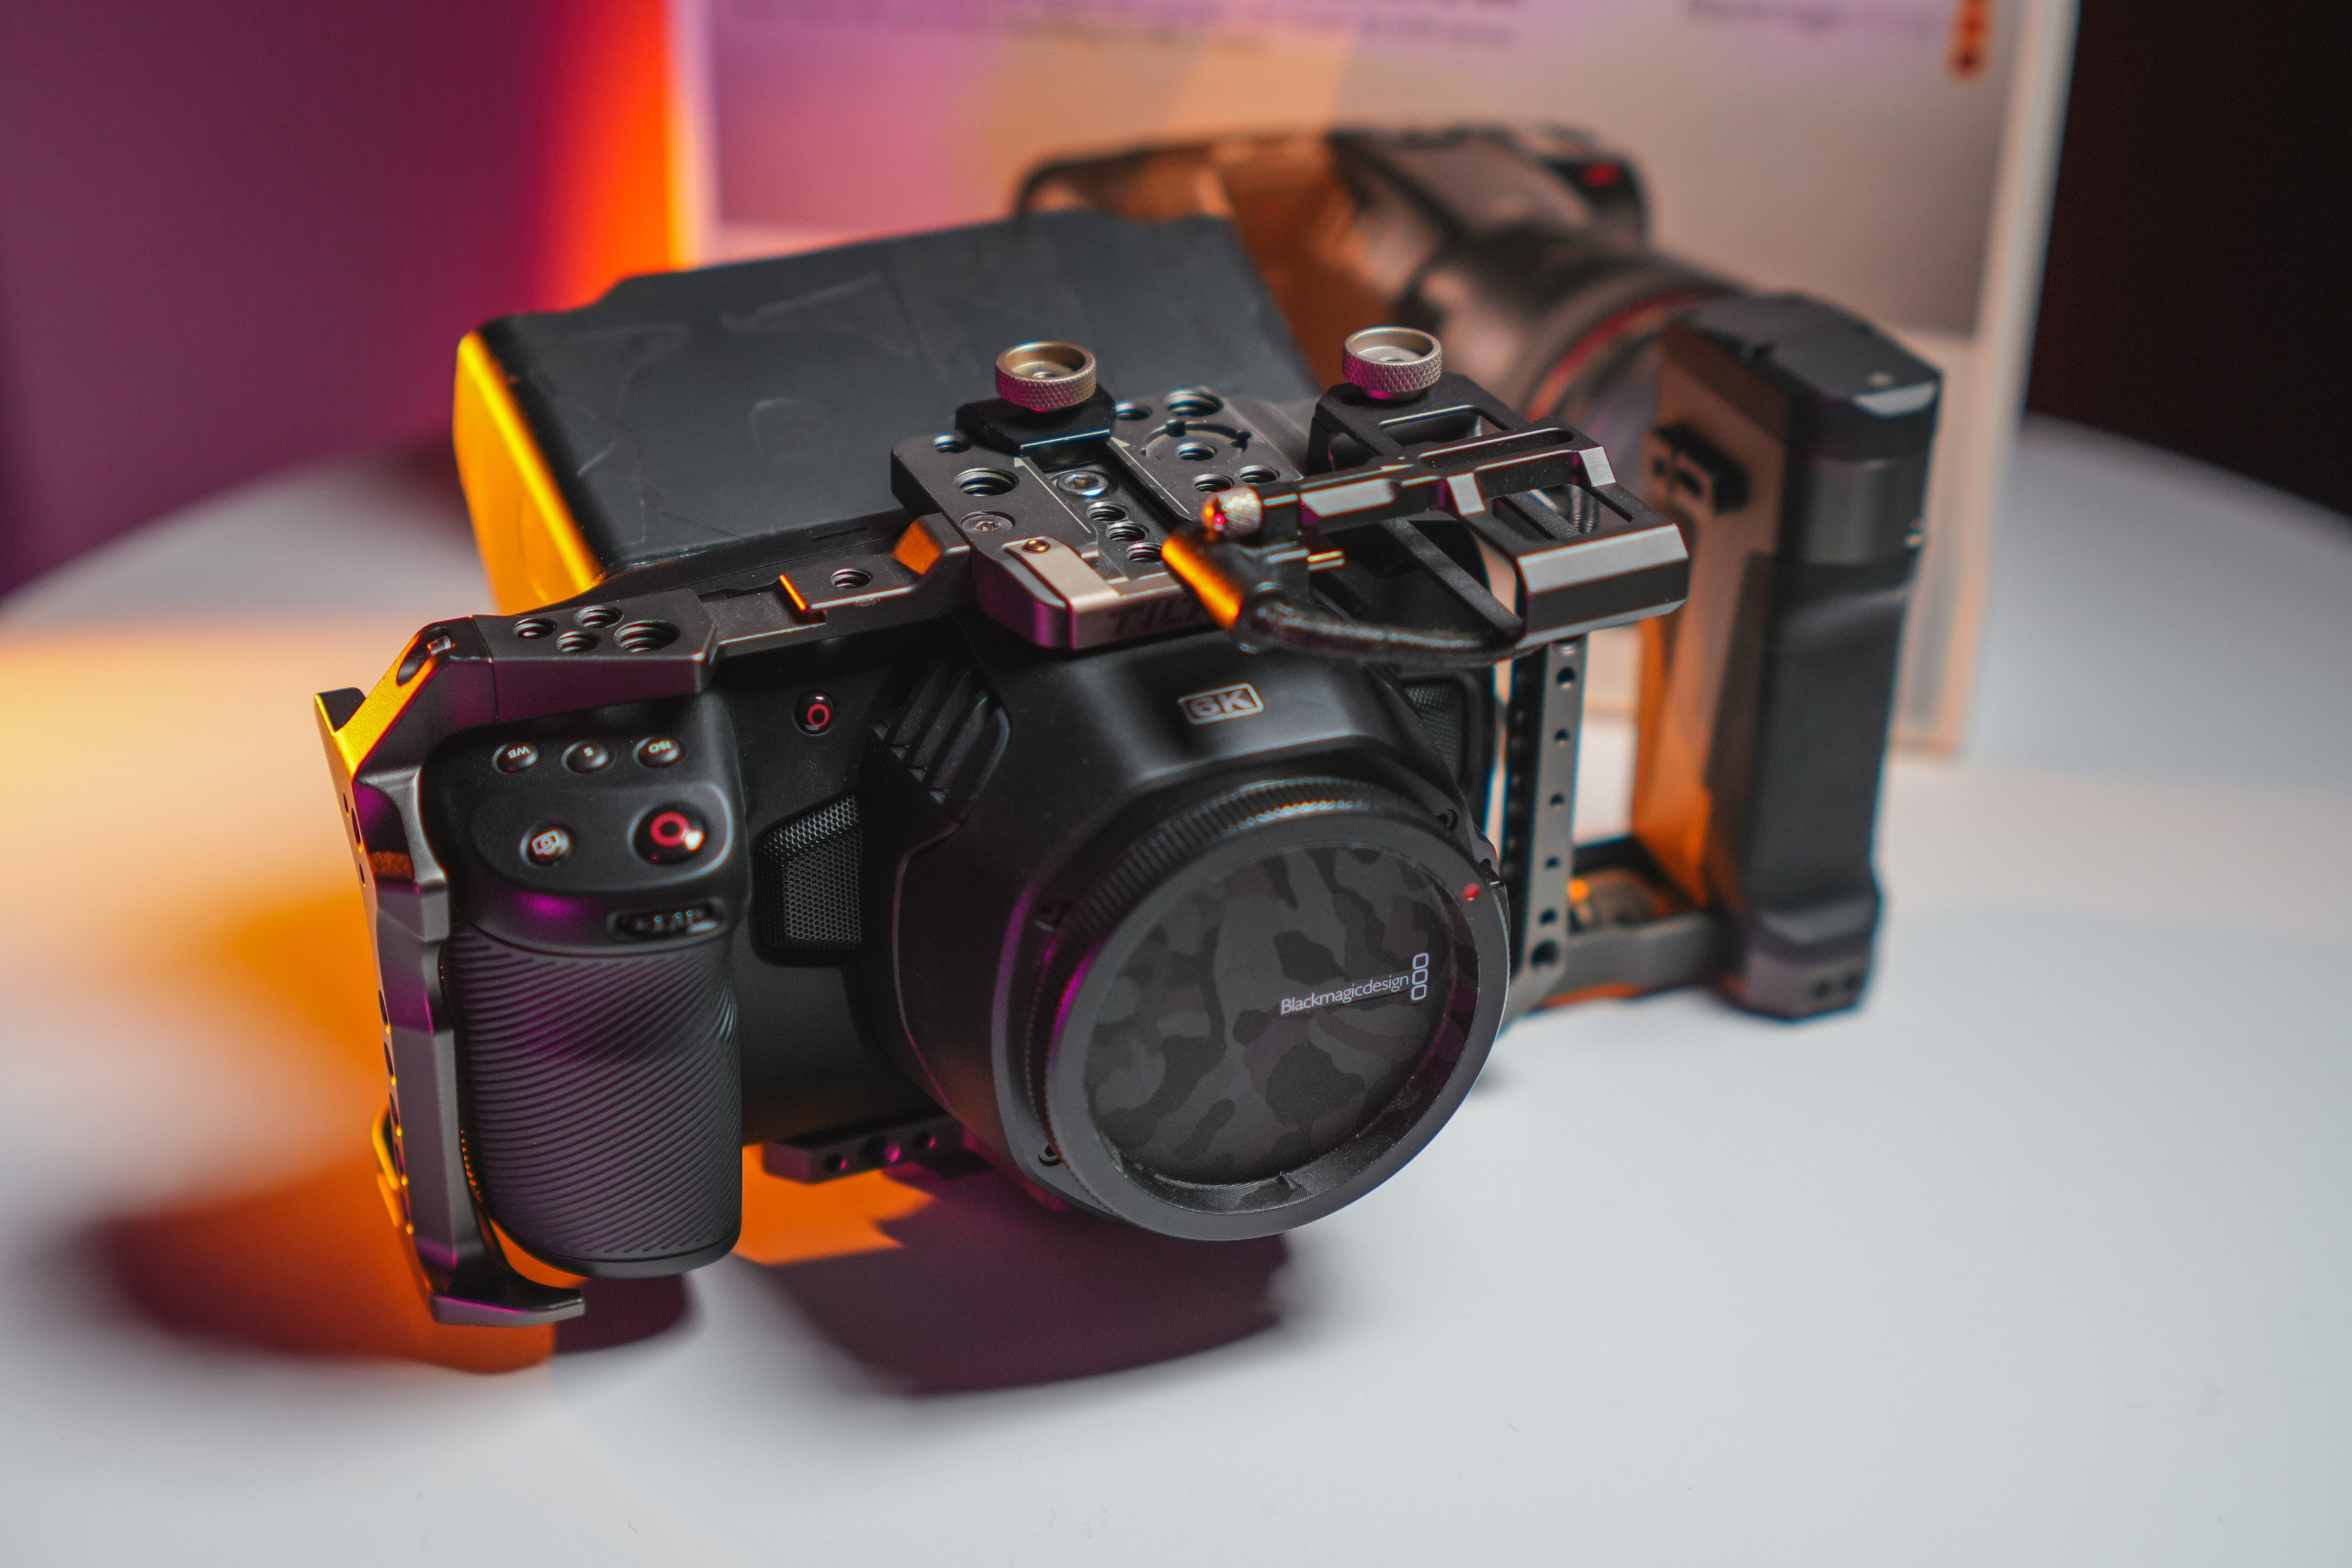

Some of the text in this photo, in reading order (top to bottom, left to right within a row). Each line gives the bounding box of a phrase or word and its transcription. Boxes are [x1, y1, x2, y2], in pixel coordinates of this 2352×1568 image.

[1107, 595, 1204, 636] TILT
[1190, 689, 1256, 717] 6K
[507, 745, 530, 759] WB
[582, 746, 594, 757] S
[648, 739, 673, 754] ISO
[1280, 974, 1409, 1016] Blackmagicdesign
